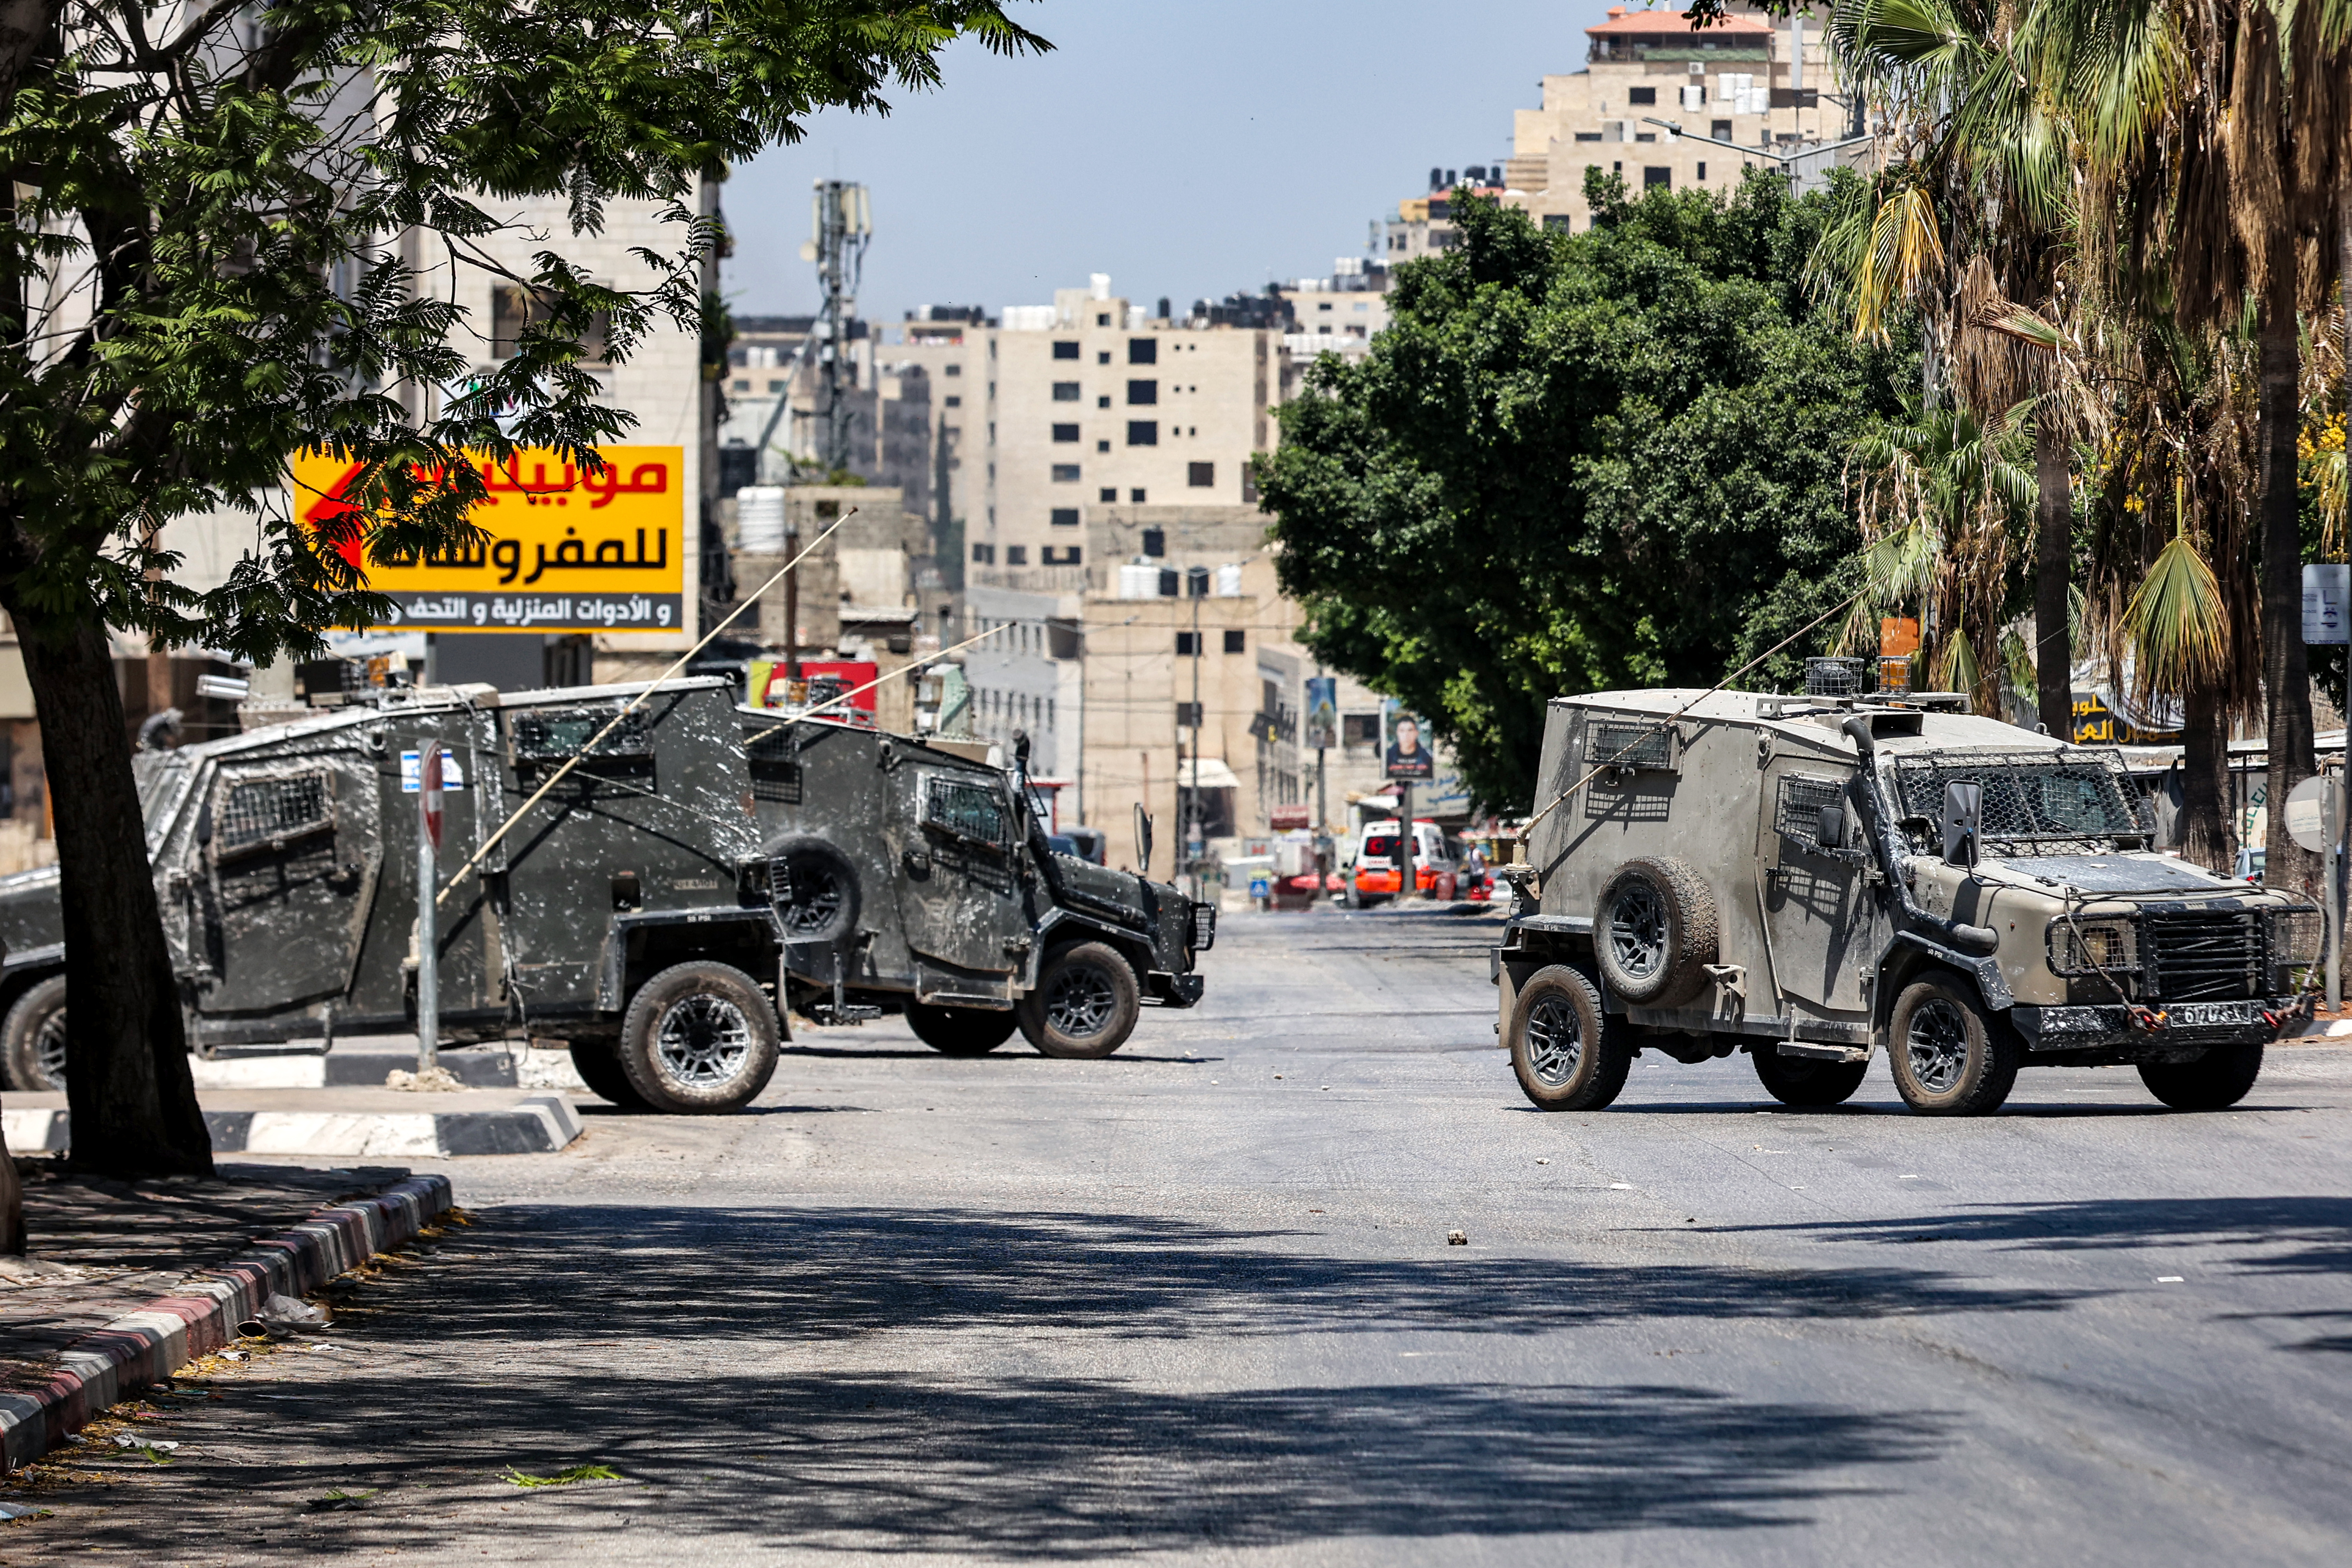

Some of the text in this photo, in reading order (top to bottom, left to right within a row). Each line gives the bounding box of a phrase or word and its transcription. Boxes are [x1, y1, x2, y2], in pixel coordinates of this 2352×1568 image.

[405, 597, 467, 619] التحف
[472, 602, 488, 626] و
[491, 597, 571, 626] المنزلية
[576, 593, 652, 626] الأدوات
[656, 603, 671, 626] و
[1934, 950, 1943, 958] PSI
